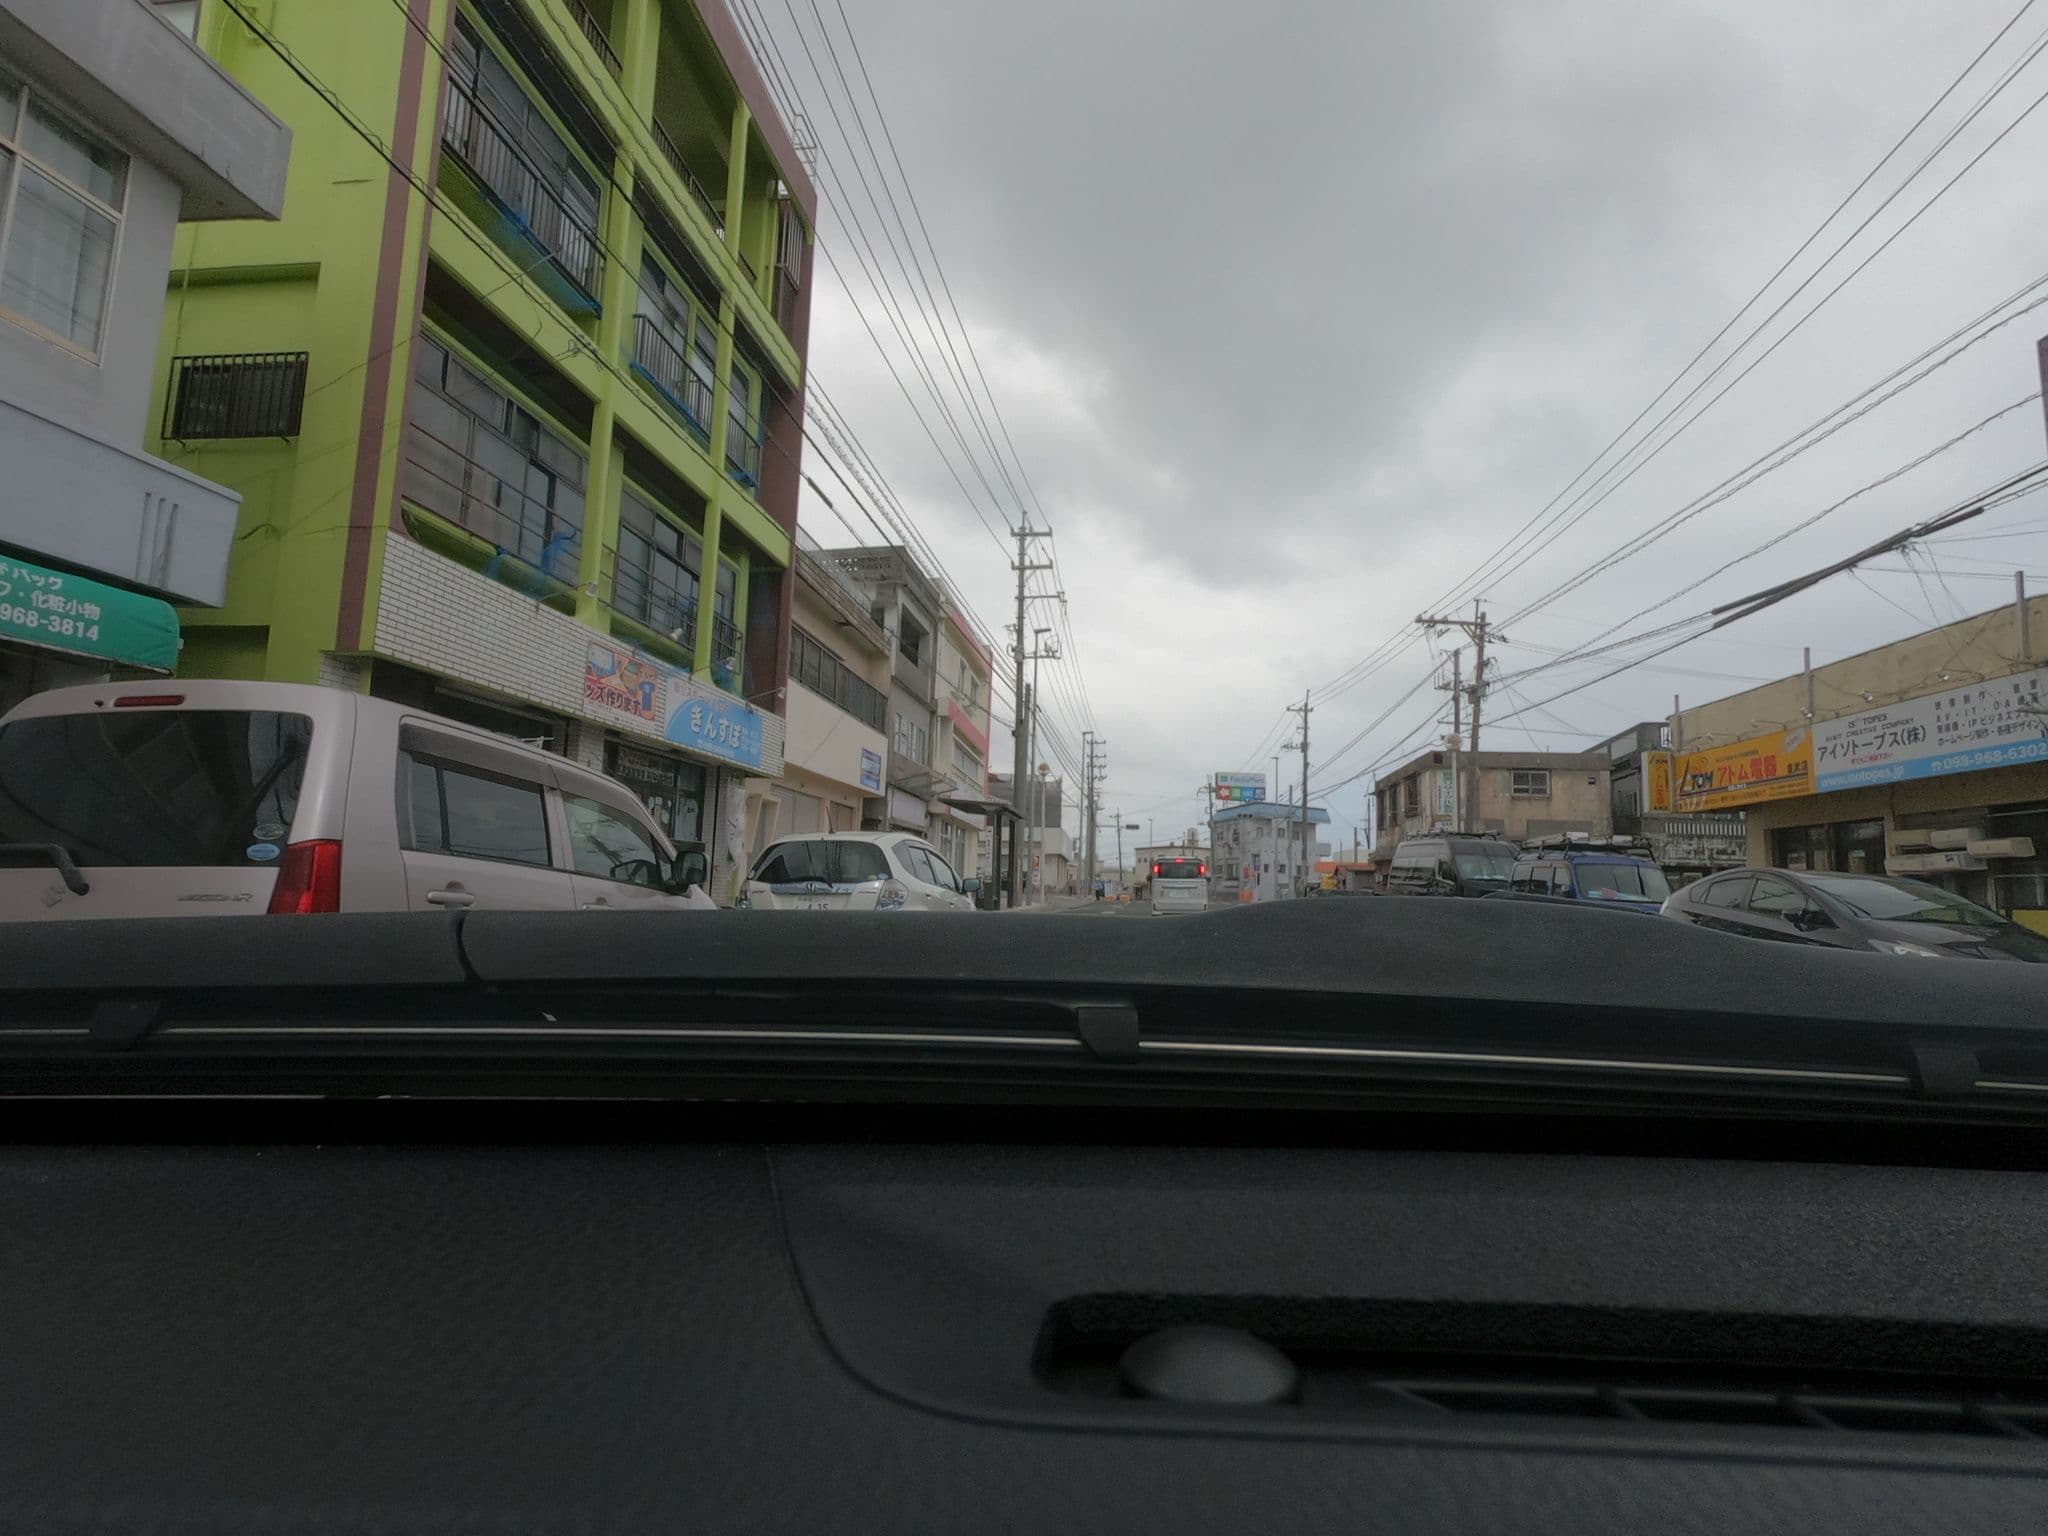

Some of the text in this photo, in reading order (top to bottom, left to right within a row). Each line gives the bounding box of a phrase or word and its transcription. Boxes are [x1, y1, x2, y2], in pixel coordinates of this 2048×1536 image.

[0, 603, 99, 641] 968-3814
[690, 704, 742, 748] きんすぽ
